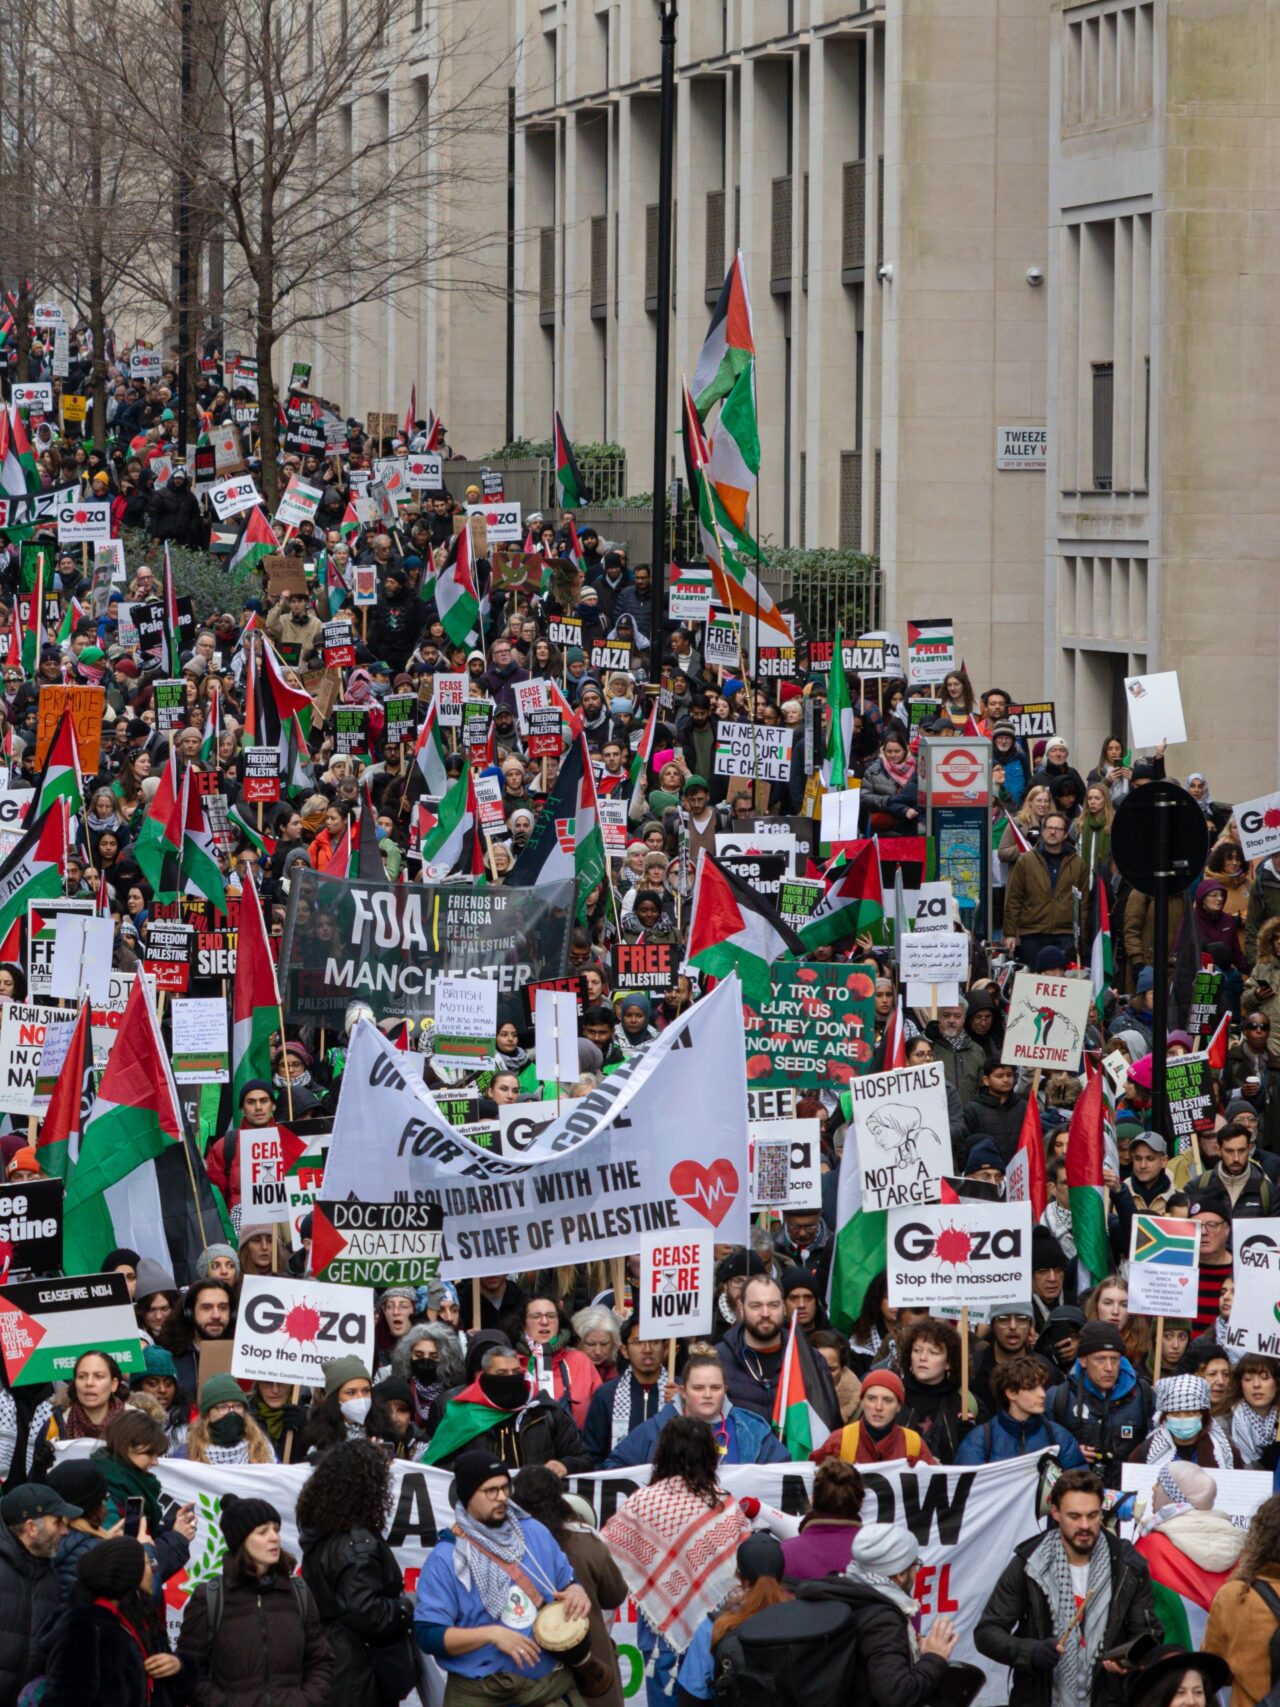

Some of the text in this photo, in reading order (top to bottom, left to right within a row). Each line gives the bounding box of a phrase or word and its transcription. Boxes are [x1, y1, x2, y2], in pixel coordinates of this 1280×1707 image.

[14, 387, 50, 400] Gza
[287, 432, 326, 448] Palestine
[298, 424, 318, 438] Free
[1005, 431, 1046, 442] TWEEZE
[1005, 445, 1036, 456] ALLEY
[592, 647, 630, 669] GAZA
[760, 647, 795, 660] END THE
[758, 659, 797, 676] SIEGE
[42, 688, 99, 712] PROMOTE
[731, 741, 751, 756] GO
[718, 757, 737, 774] LE
[448, 896, 508, 911] FRIENDS OF
[351, 888, 428, 952] FOA
[447, 910, 492, 926] AL-AQSA
[460, 936, 516, 954] PALESTINE
[618, 943, 672, 973] FREE
[323, 958, 532, 996] MANCHESTER
[619, 972, 672, 987] PALESTINE
[442, 988, 482, 1002] BRITISH
[788, 984, 850, 1001] TRY TO
[1035, 982, 1068, 998] FREE
[9, 1005, 39, 1023] RISHI
[439, 1002, 486, 1014] MOTHER
[761, 1000, 831, 1019] BURY US
[768, 1018, 864, 1039] THEY DON'T
[792, 1039, 859, 1058] WE ARE
[1014, 1044, 1070, 1062] PALESTINE
[775, 1056, 827, 1074] SEEDS
[854, 1066, 941, 1101] HOSPITALS
[864, 1160, 930, 1190] NOT A
[413, 1159, 641, 1218] SOLIDARITY WITH THE
[871, 1178, 942, 1208] TARGE
[333, 1203, 429, 1230] DOCTORS
[458, 1198, 681, 1262] STAFF OF PALESTINE
[348, 1231, 441, 1256] AGAINST
[651, 1243, 701, 1268] CEASE
[327, 1258, 436, 1283] GENOCIDE
[651, 1265, 700, 1294] FRE
[651, 1290, 700, 1318] NOW!
